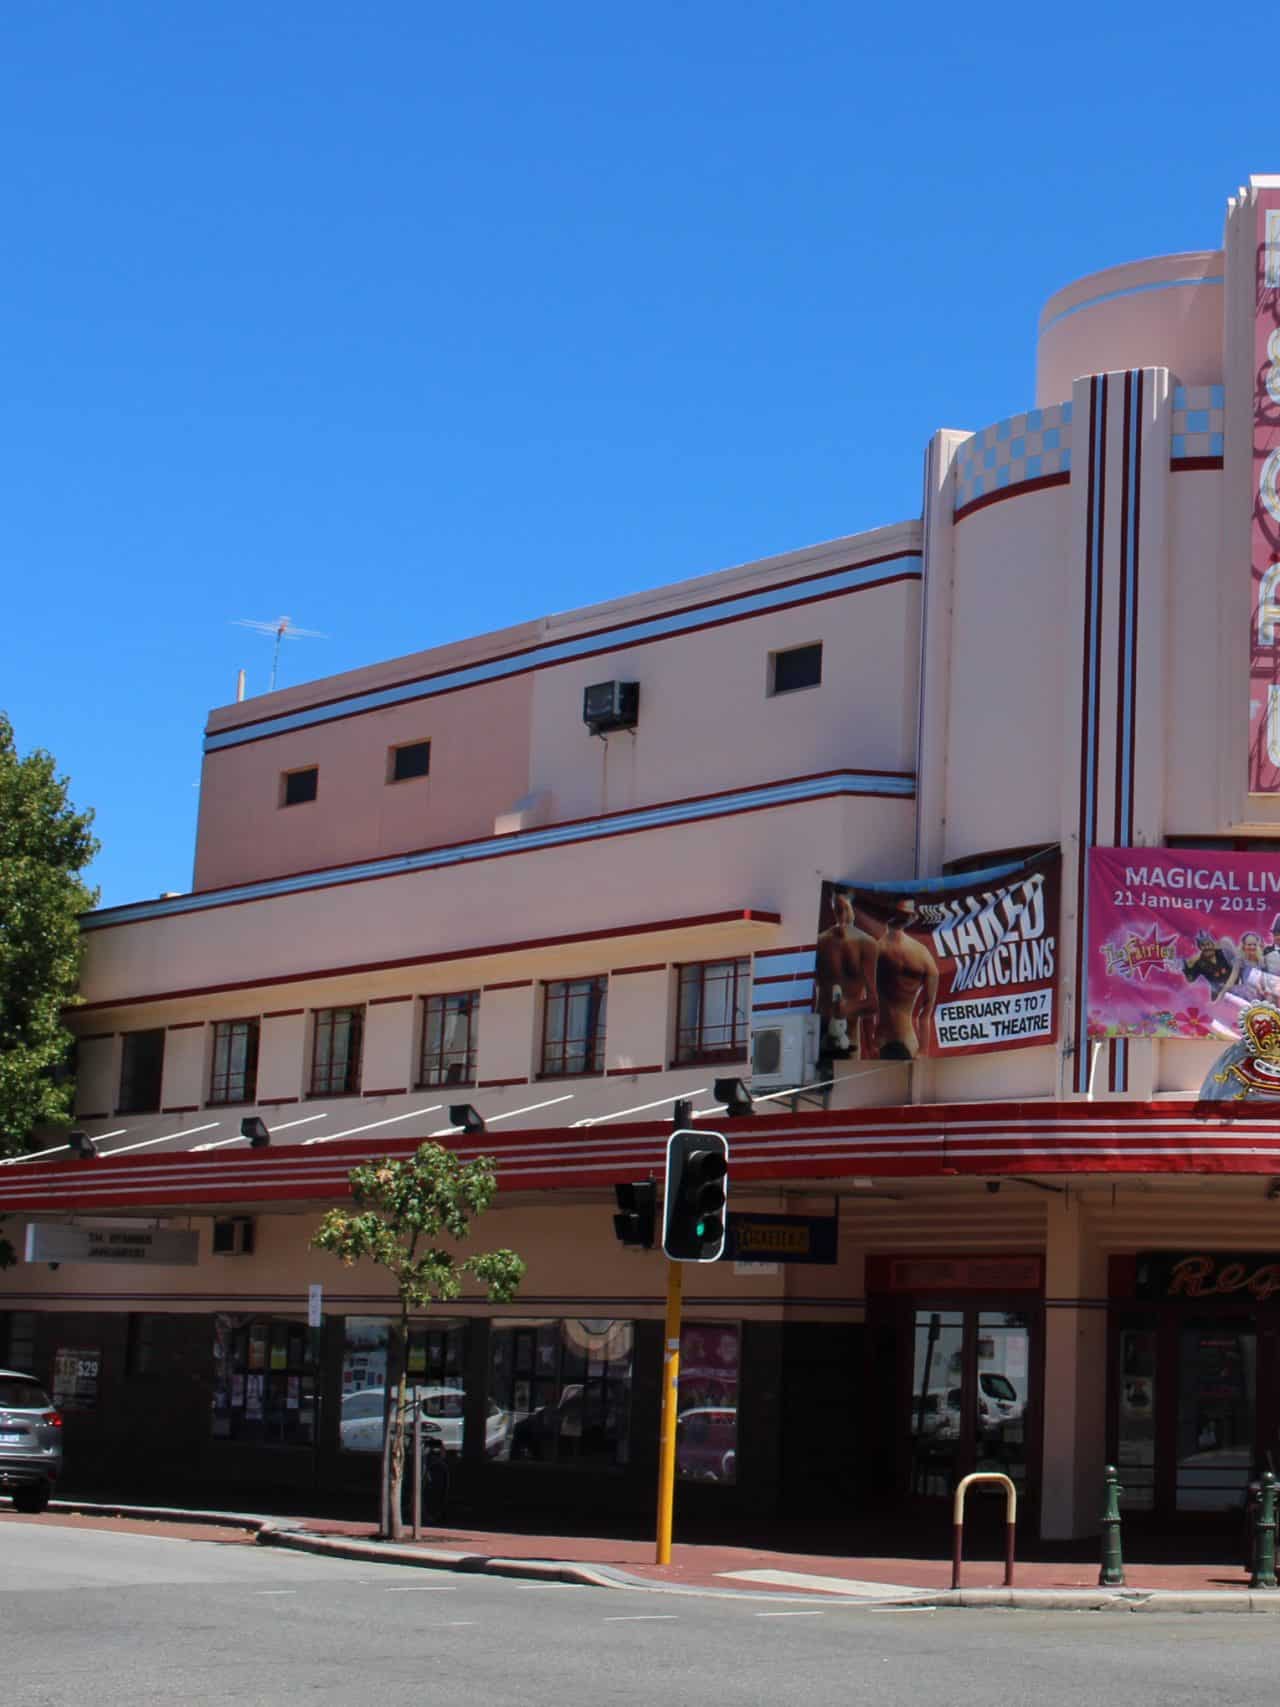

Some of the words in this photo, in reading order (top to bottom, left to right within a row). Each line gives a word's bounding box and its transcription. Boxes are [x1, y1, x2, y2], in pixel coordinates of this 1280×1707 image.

[1125, 866, 1240, 891] MAGICAL
[932, 872, 1045, 957] NAKED
[1114, 890, 1135, 906] 21
[1139, 891, 1214, 913] January
[1220, 896, 1267, 911] 2015
[950, 937, 1056, 992] MAGICIANS
[941, 999, 1011, 1022] FEBRUARY
[1015, 997, 1021, 1013] 5
[1023, 996, 1038, 1012] TO
[1039, 994, 1046, 1010] 7
[938, 1023, 989, 1043] REGAL
[991, 1013, 1049, 1037] THEATRE
